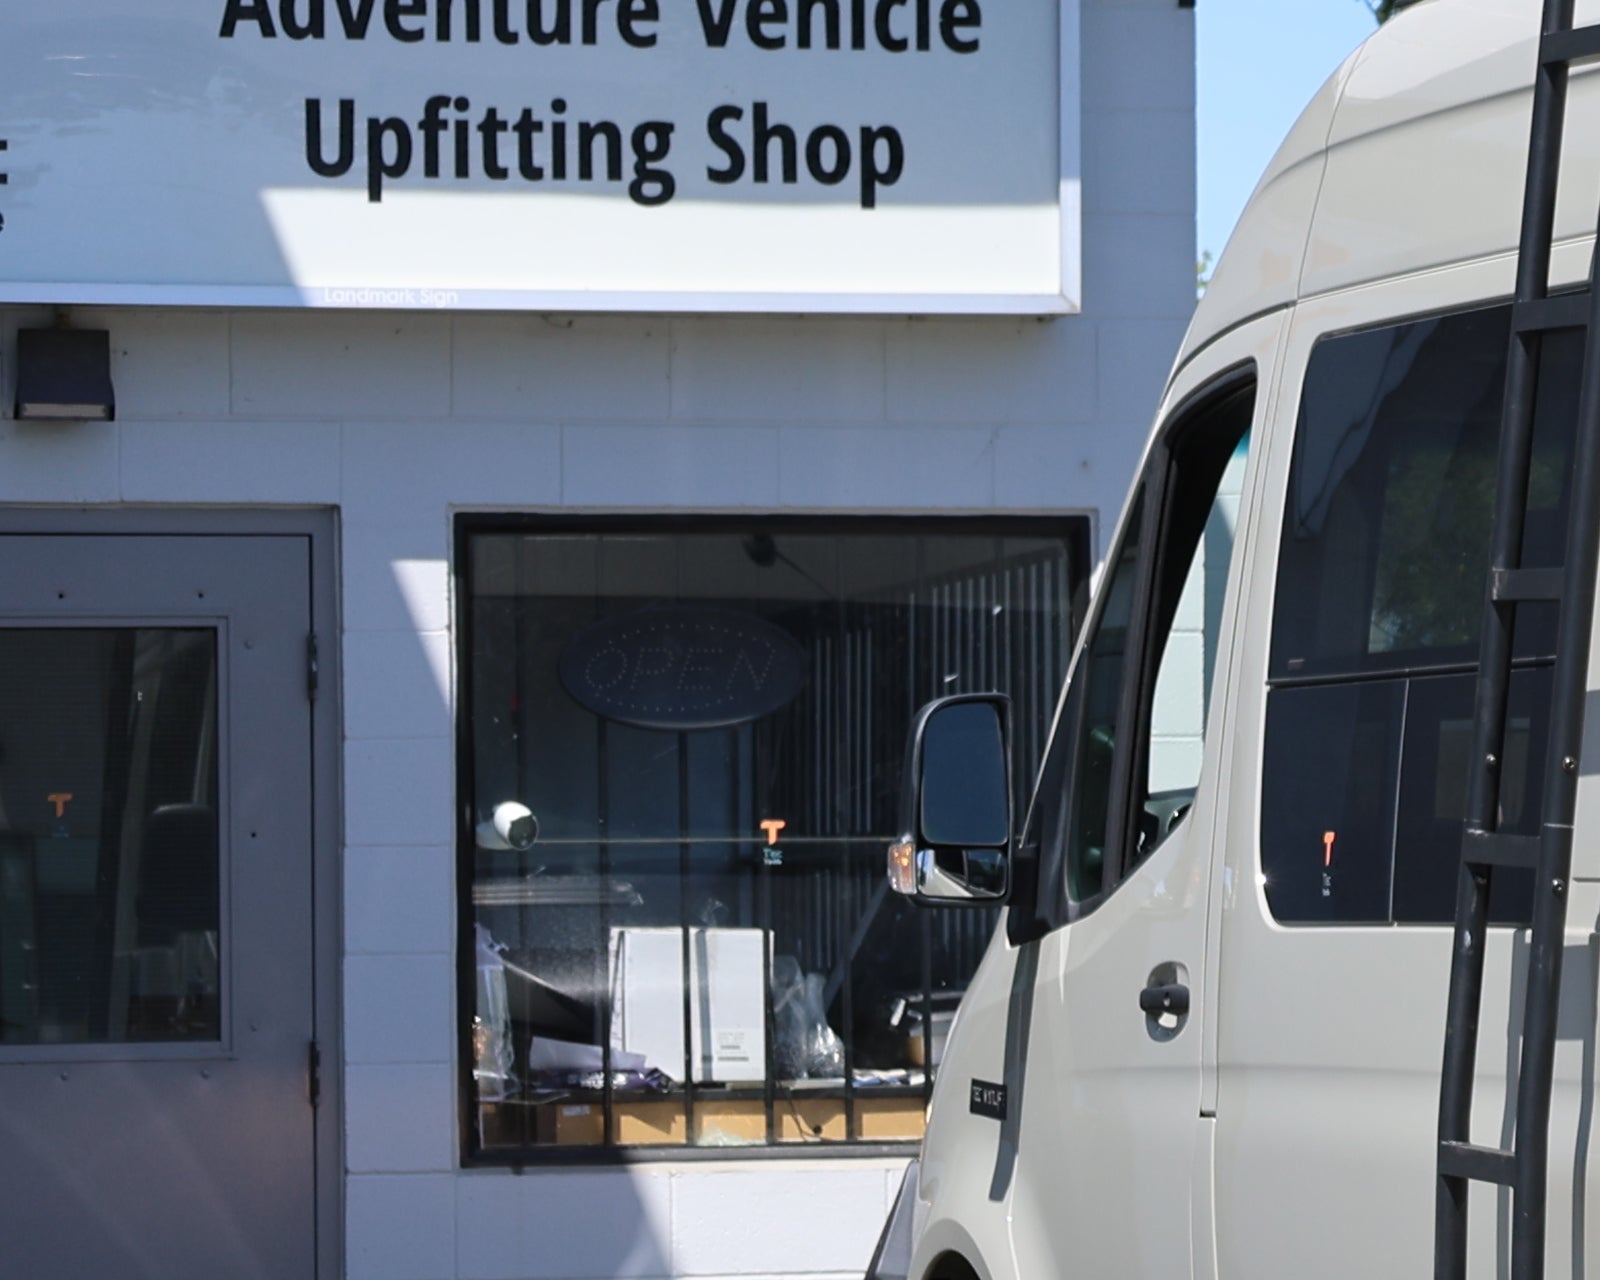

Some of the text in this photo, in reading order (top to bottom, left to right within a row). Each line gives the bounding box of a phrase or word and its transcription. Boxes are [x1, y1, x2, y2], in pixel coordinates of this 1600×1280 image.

[305, 94, 906, 209] Upfitting Shop
[324, 287, 459, 308] Landmark Sign
[585, 646, 777, 691] OPEN
